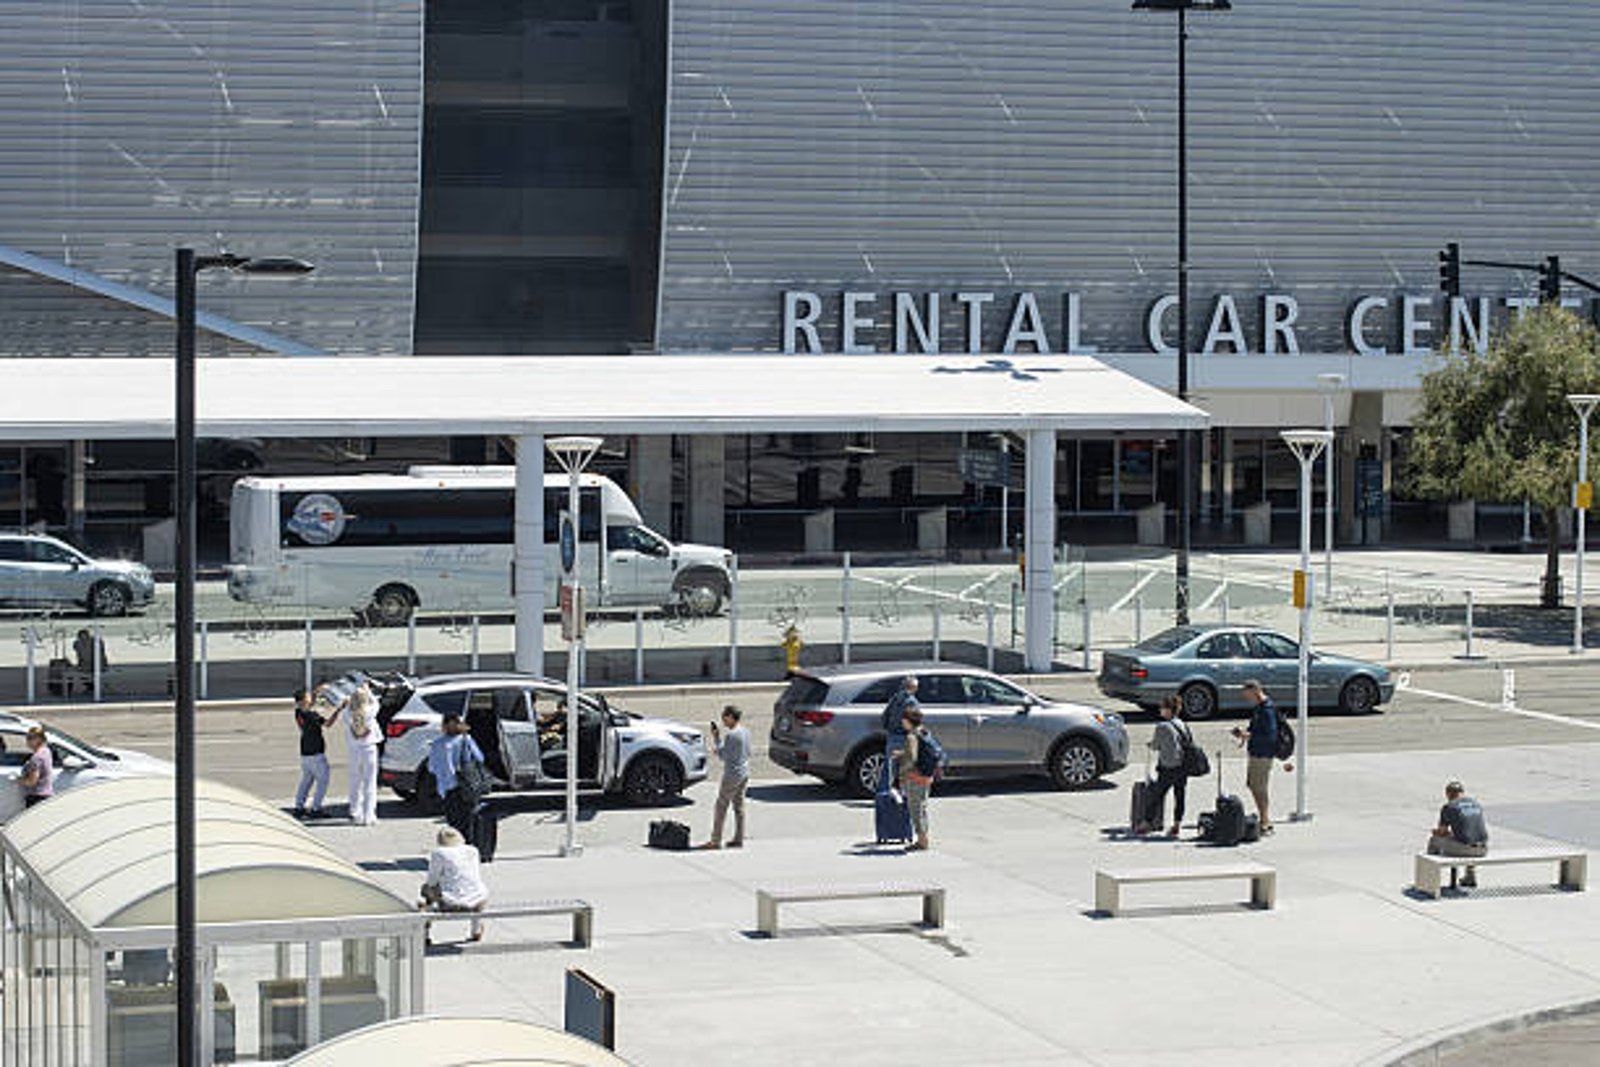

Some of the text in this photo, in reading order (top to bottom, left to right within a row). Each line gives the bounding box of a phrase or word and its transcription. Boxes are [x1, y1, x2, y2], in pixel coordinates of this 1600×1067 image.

[784, 291, 1583, 357] RENTAL CAR CENT
